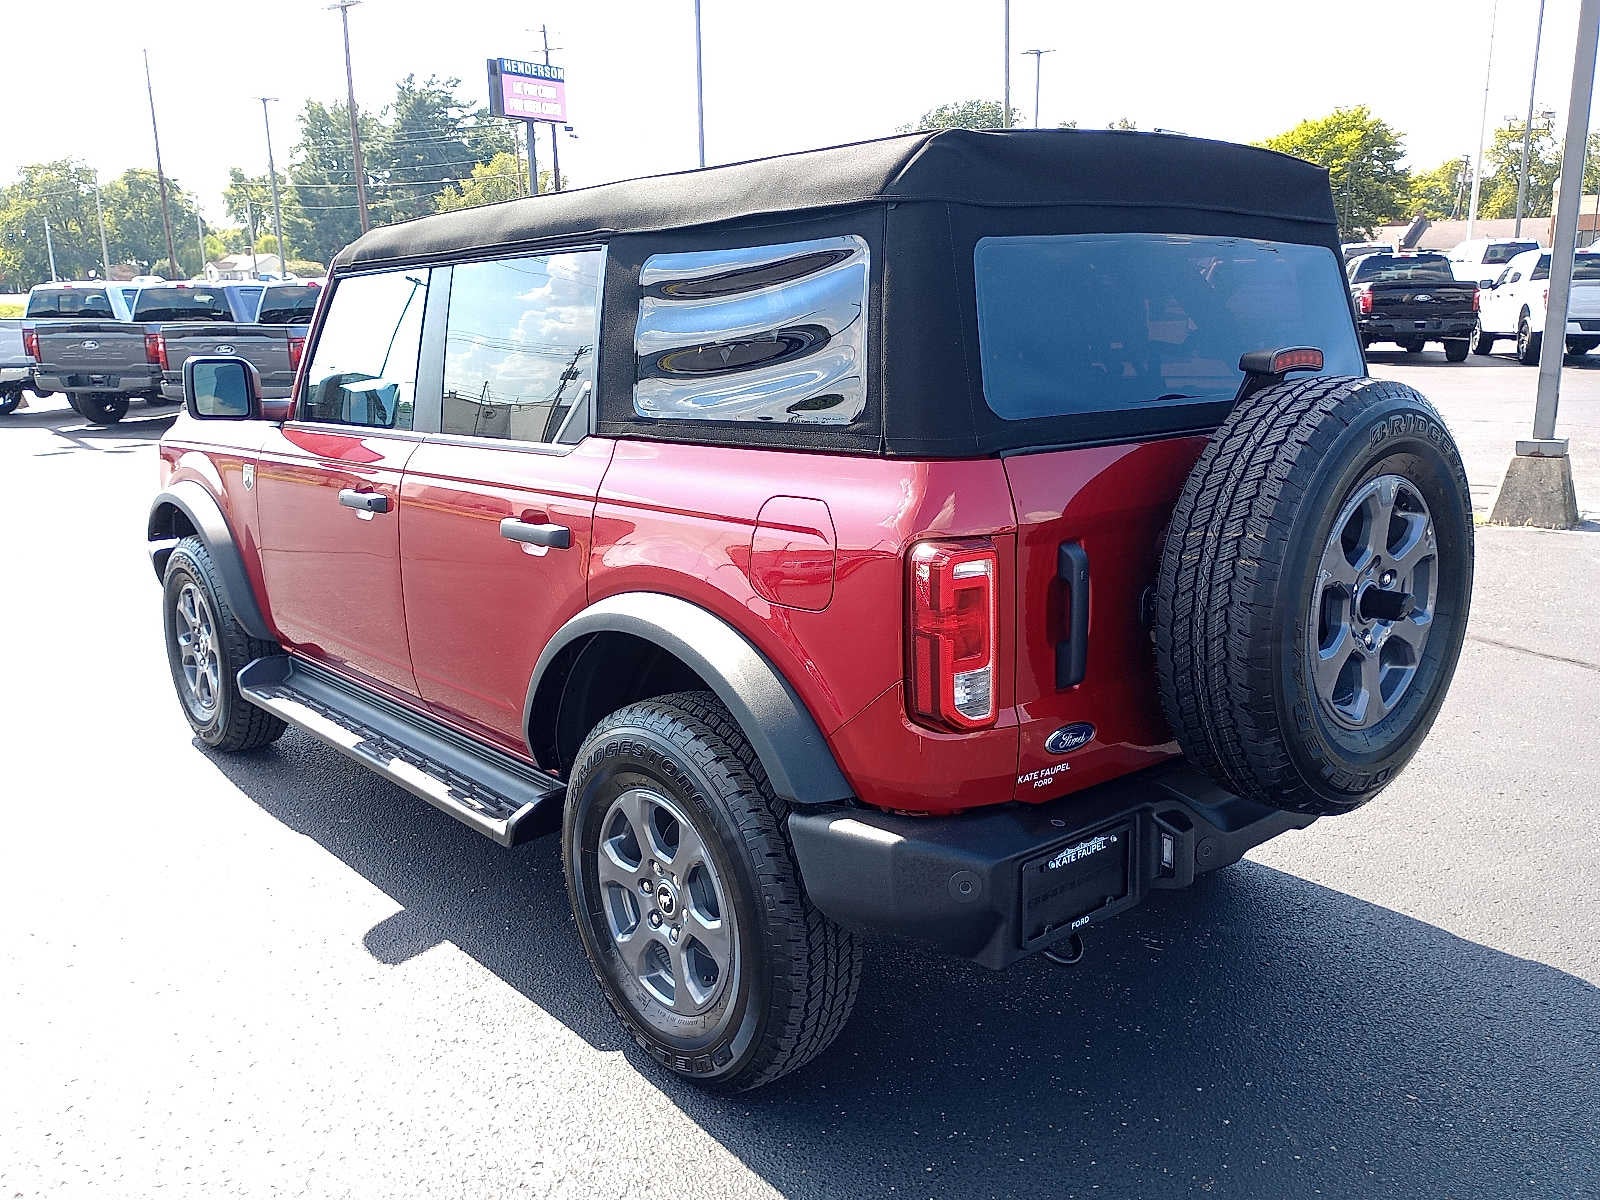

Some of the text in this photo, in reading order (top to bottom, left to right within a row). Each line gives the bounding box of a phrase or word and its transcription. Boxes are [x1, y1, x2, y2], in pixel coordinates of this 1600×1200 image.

[503, 59, 564, 80] HENDERSON
[1058, 730, 1087, 749] Ford
[1017, 762, 1071, 784] KATE FAUPEL
[1033, 777, 1053, 789] FORD
[1055, 840, 1106, 869] KATE FAUPEL
[1071, 915, 1090, 930] FORD
